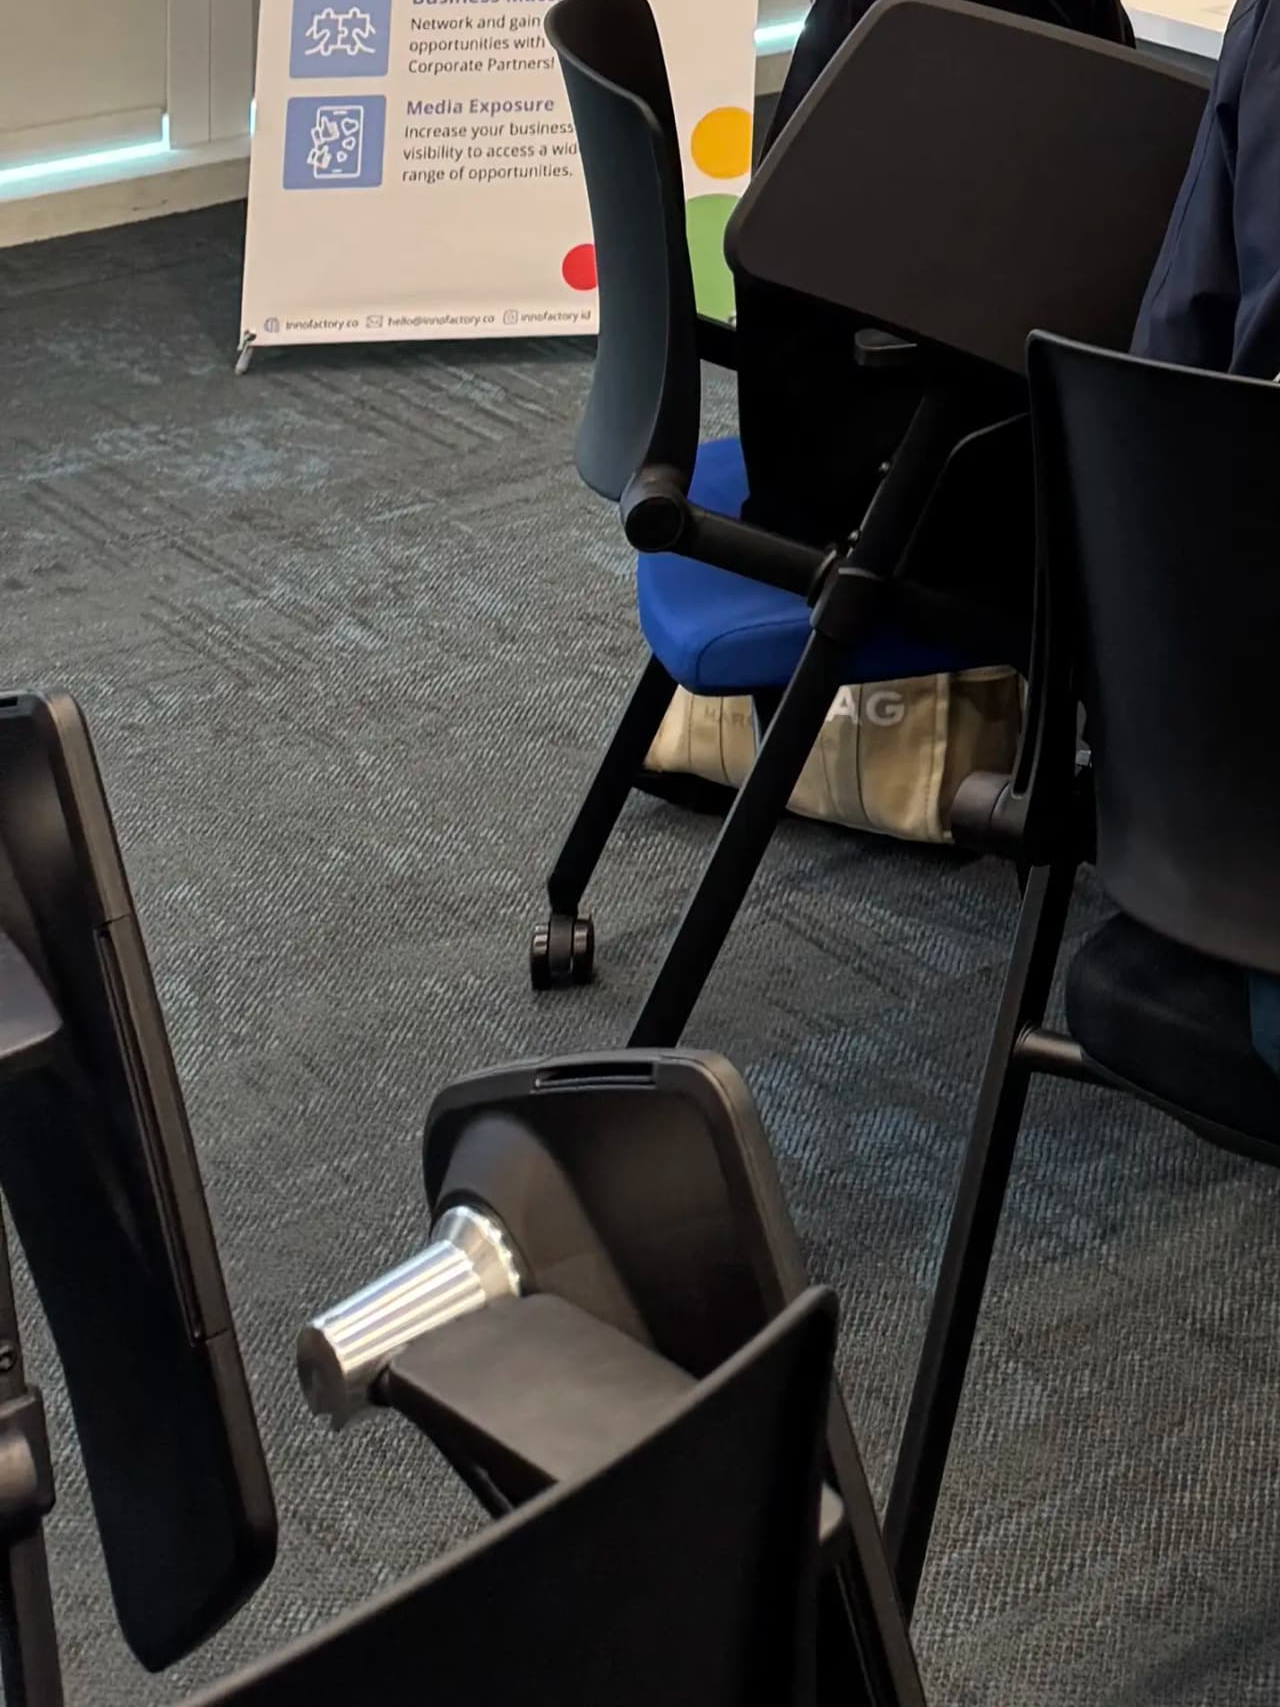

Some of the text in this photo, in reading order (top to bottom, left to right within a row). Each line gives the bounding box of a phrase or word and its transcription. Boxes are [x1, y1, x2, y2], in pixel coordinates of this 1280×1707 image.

[411, 16, 540, 32] Network and gain
[409, 36, 545, 54] opportunities with
[408, 57, 554, 76] Corporate Partners!
[407, 98, 554, 118] Media Exposure
[405, 121, 573, 140] Increase your business
[403, 142, 577, 162] visibility to access a wid
[402, 164, 573, 183] range of opportunities.
